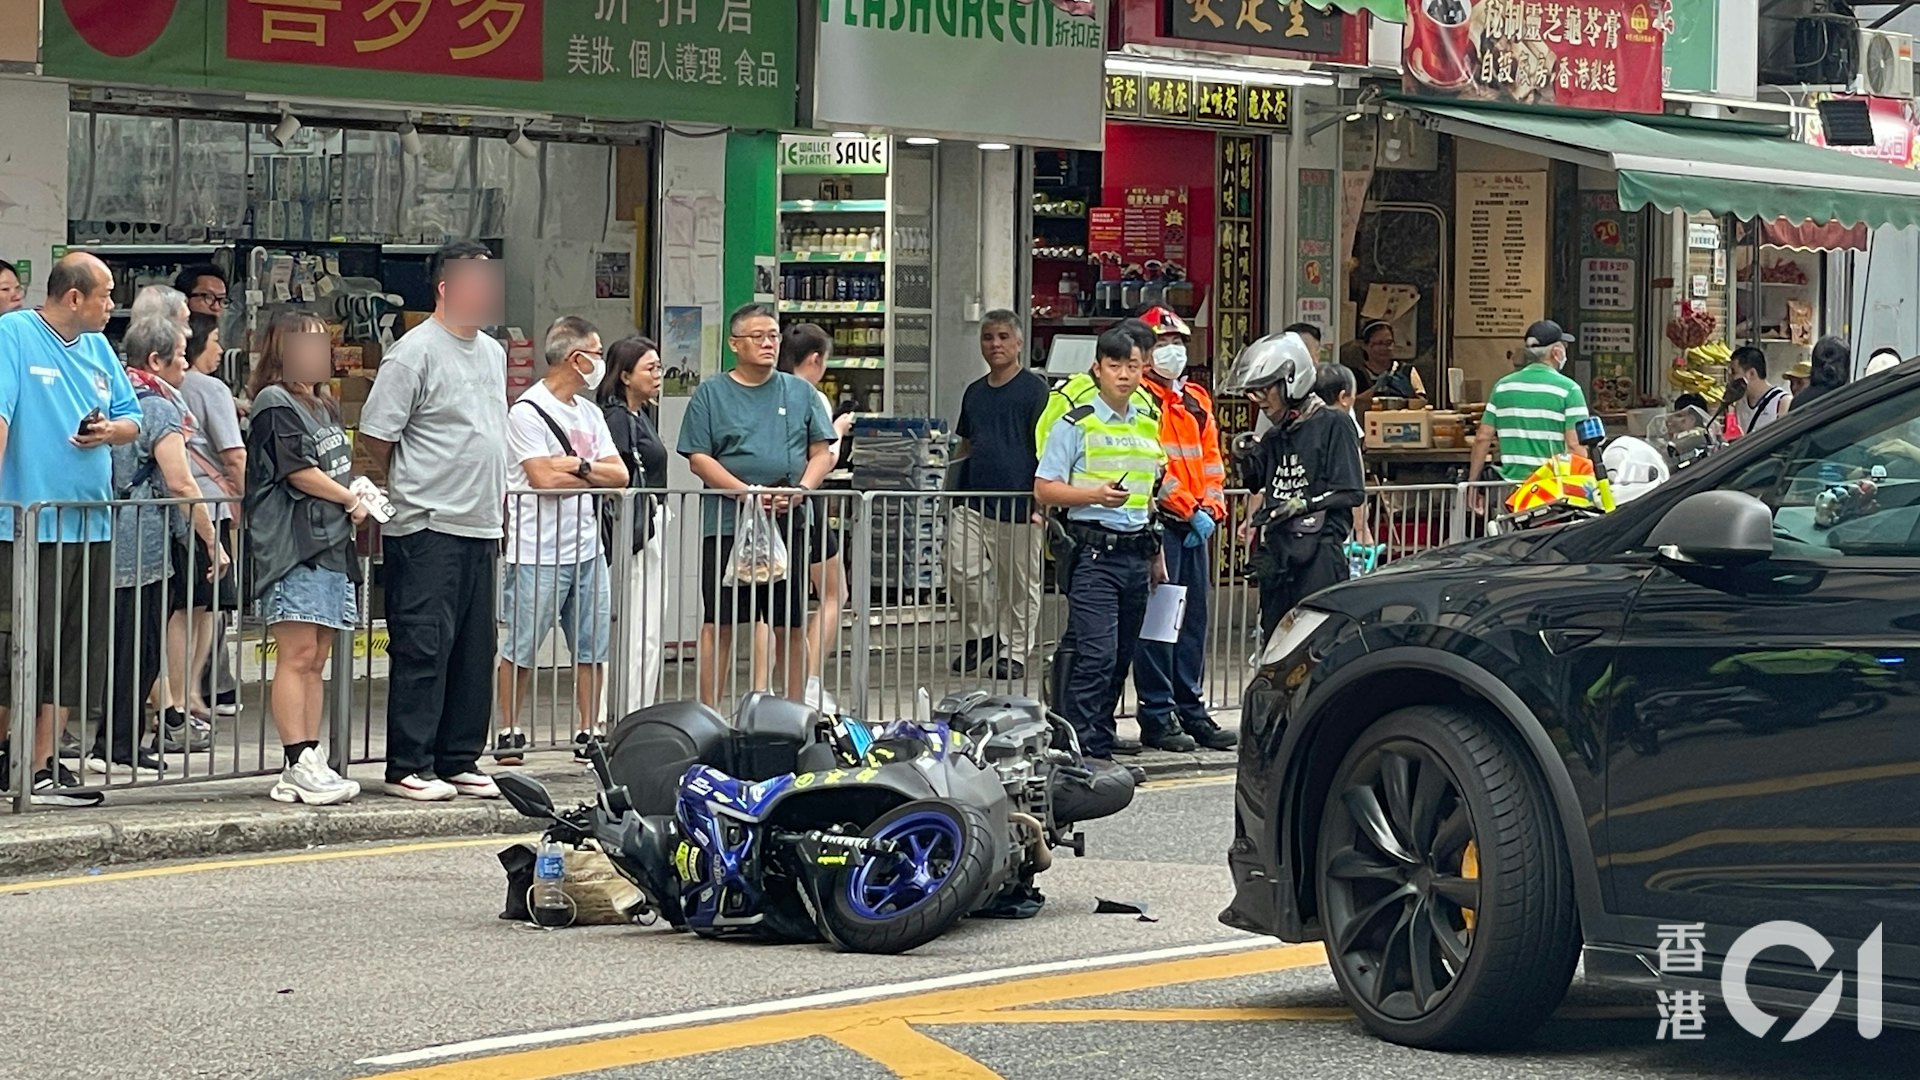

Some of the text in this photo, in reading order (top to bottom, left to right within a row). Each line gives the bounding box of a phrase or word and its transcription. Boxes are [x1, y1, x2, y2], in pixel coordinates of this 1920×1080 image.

[819, 0, 1053, 47] LASHGREEN
[1055, 20, 1100, 49] 折扣店
[734, 48, 778, 88] 食品
[799, 141, 831, 153] WALLET
[799, 154, 831, 166] PLANET
[836, 141, 881, 164] SAVE
